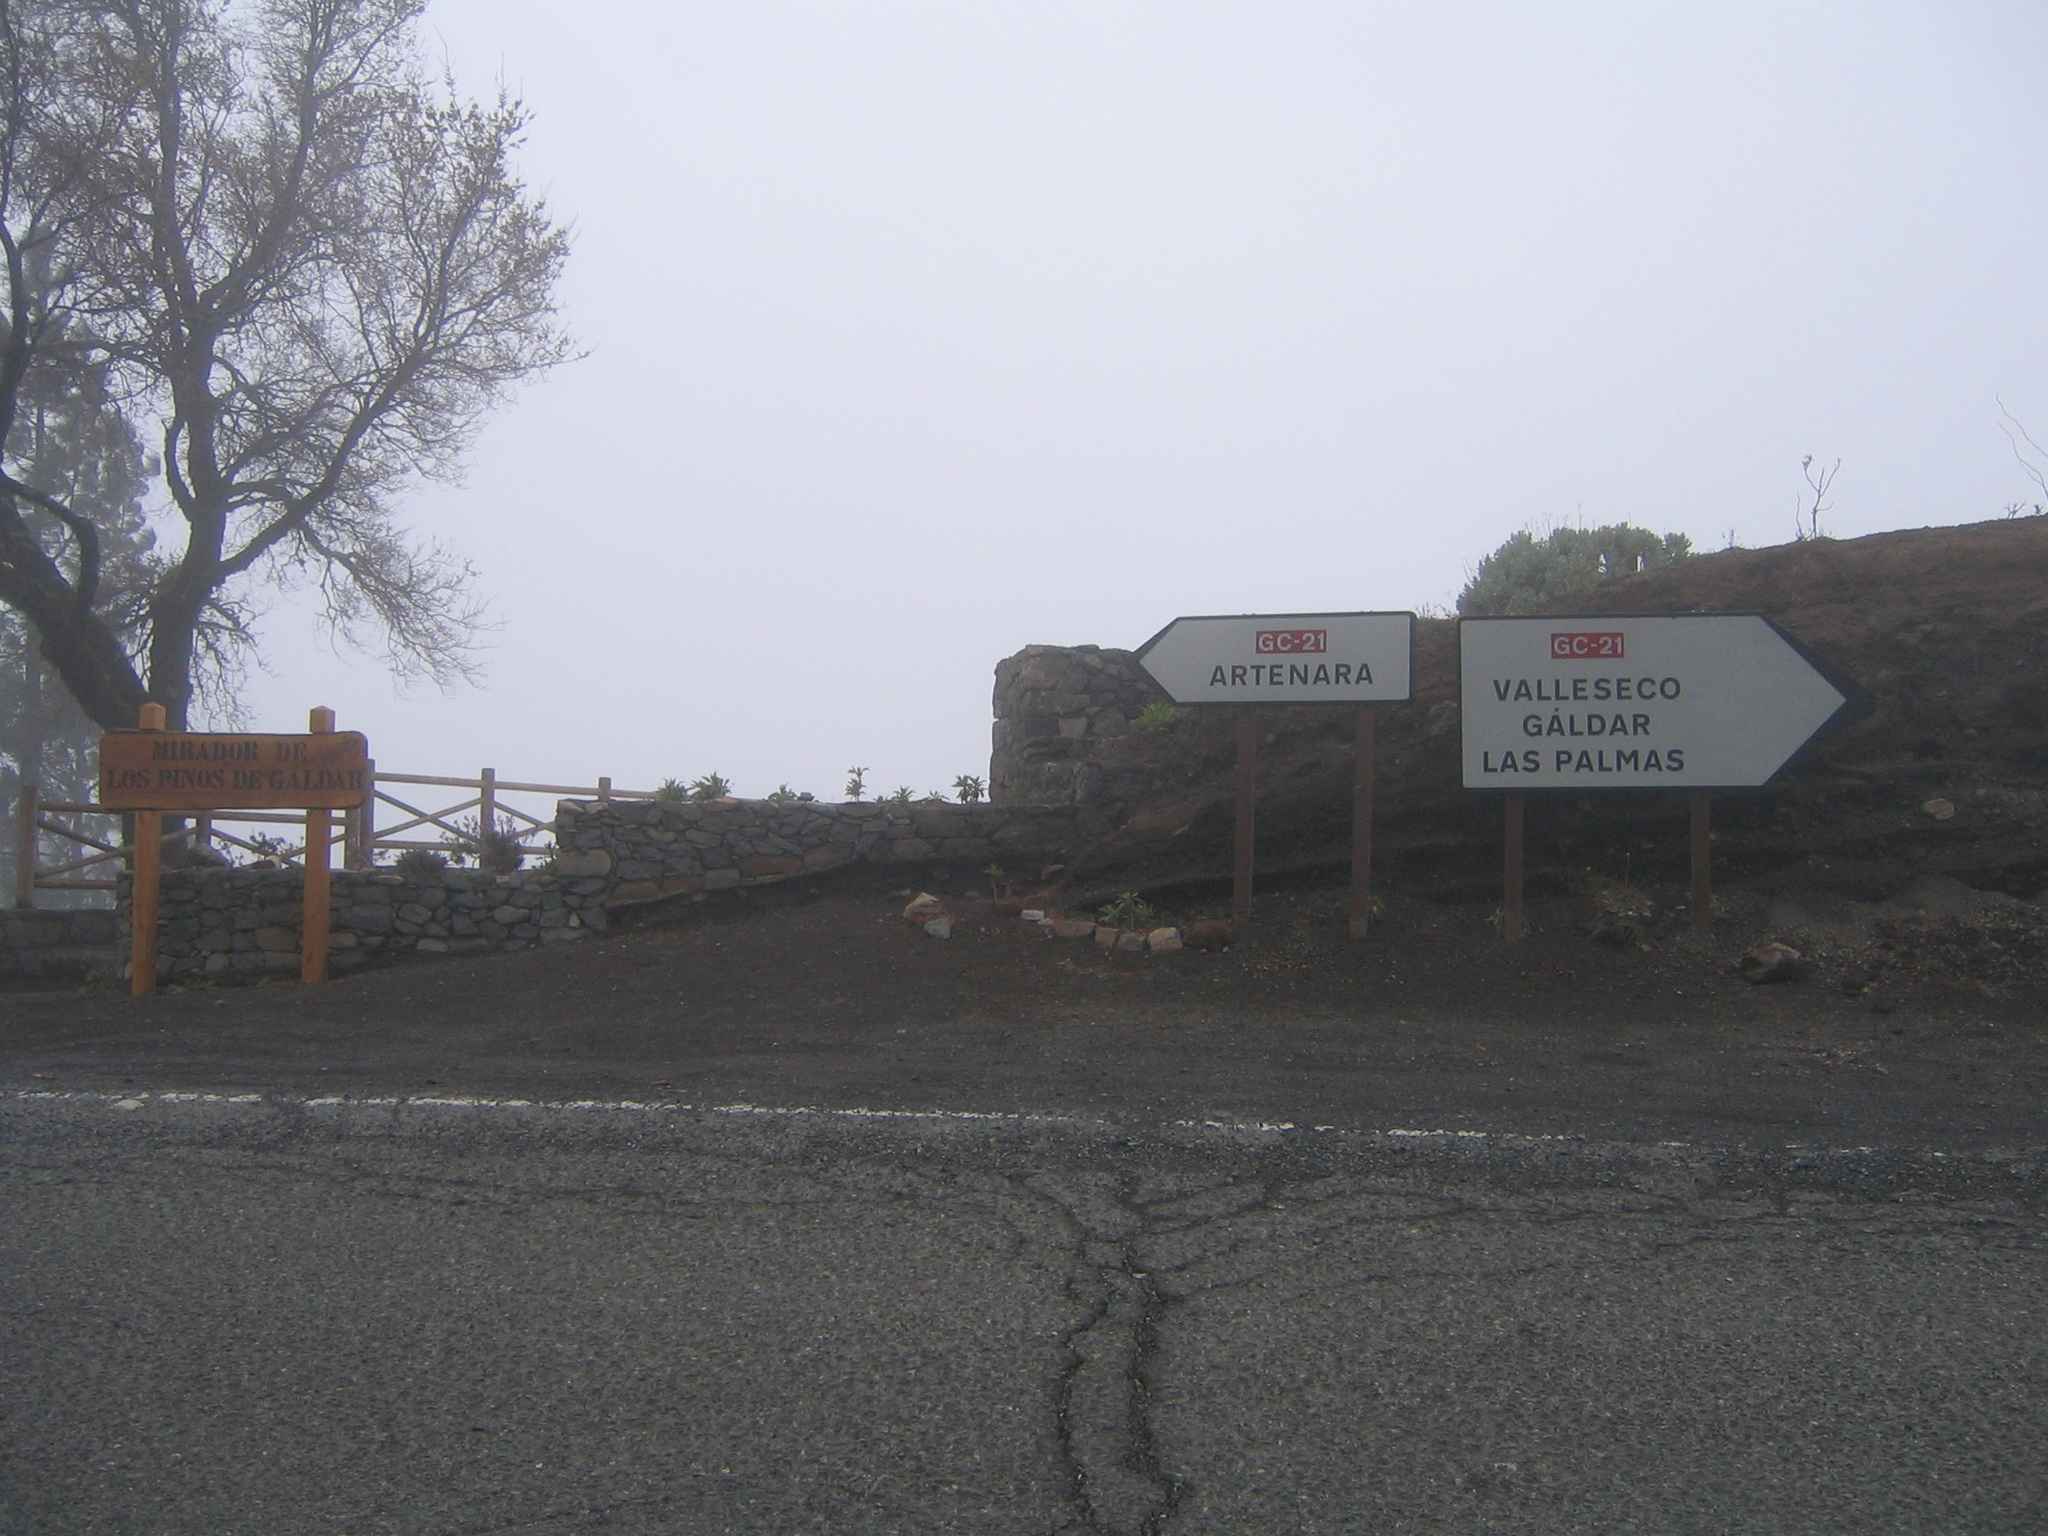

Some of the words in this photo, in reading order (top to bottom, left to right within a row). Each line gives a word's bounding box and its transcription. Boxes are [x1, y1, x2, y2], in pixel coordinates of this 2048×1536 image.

[1258, 633, 1326, 652] GC-21
[1553, 636, 1623, 655] GC-21
[1210, 663, 1373, 686] ARTENARA
[1493, 677, 1681, 701] VALLESECO
[1523, 707, 1651, 737] GÁLDAR
[153, 740, 257, 761] MIRADOR
[277, 742, 307, 761] DE
[1483, 749, 1541, 774] LAS
[1555, 748, 1685, 773] PALMAS
[108, 769, 153, 790] LOS
[160, 769, 225, 790] PINOS
[232, 770, 258, 790] DE
